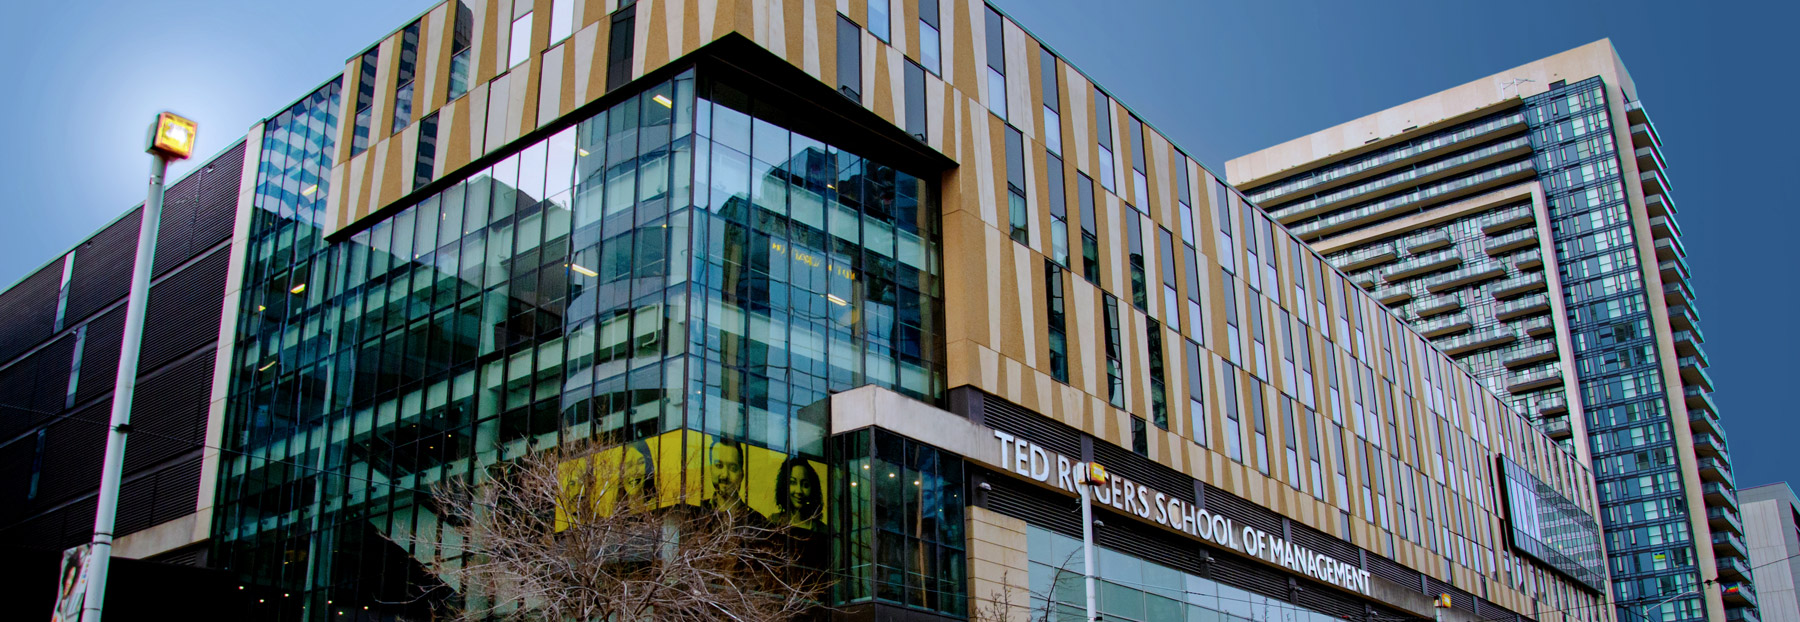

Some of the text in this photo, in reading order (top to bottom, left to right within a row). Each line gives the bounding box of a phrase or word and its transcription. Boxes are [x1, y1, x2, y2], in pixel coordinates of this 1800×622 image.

[994, 430, 1050, 482] TED
[1155, 492, 1239, 550] SCHOOL
[1242, 526, 1266, 558] OF
[1269, 534, 1371, 597] MANAGEMENT
